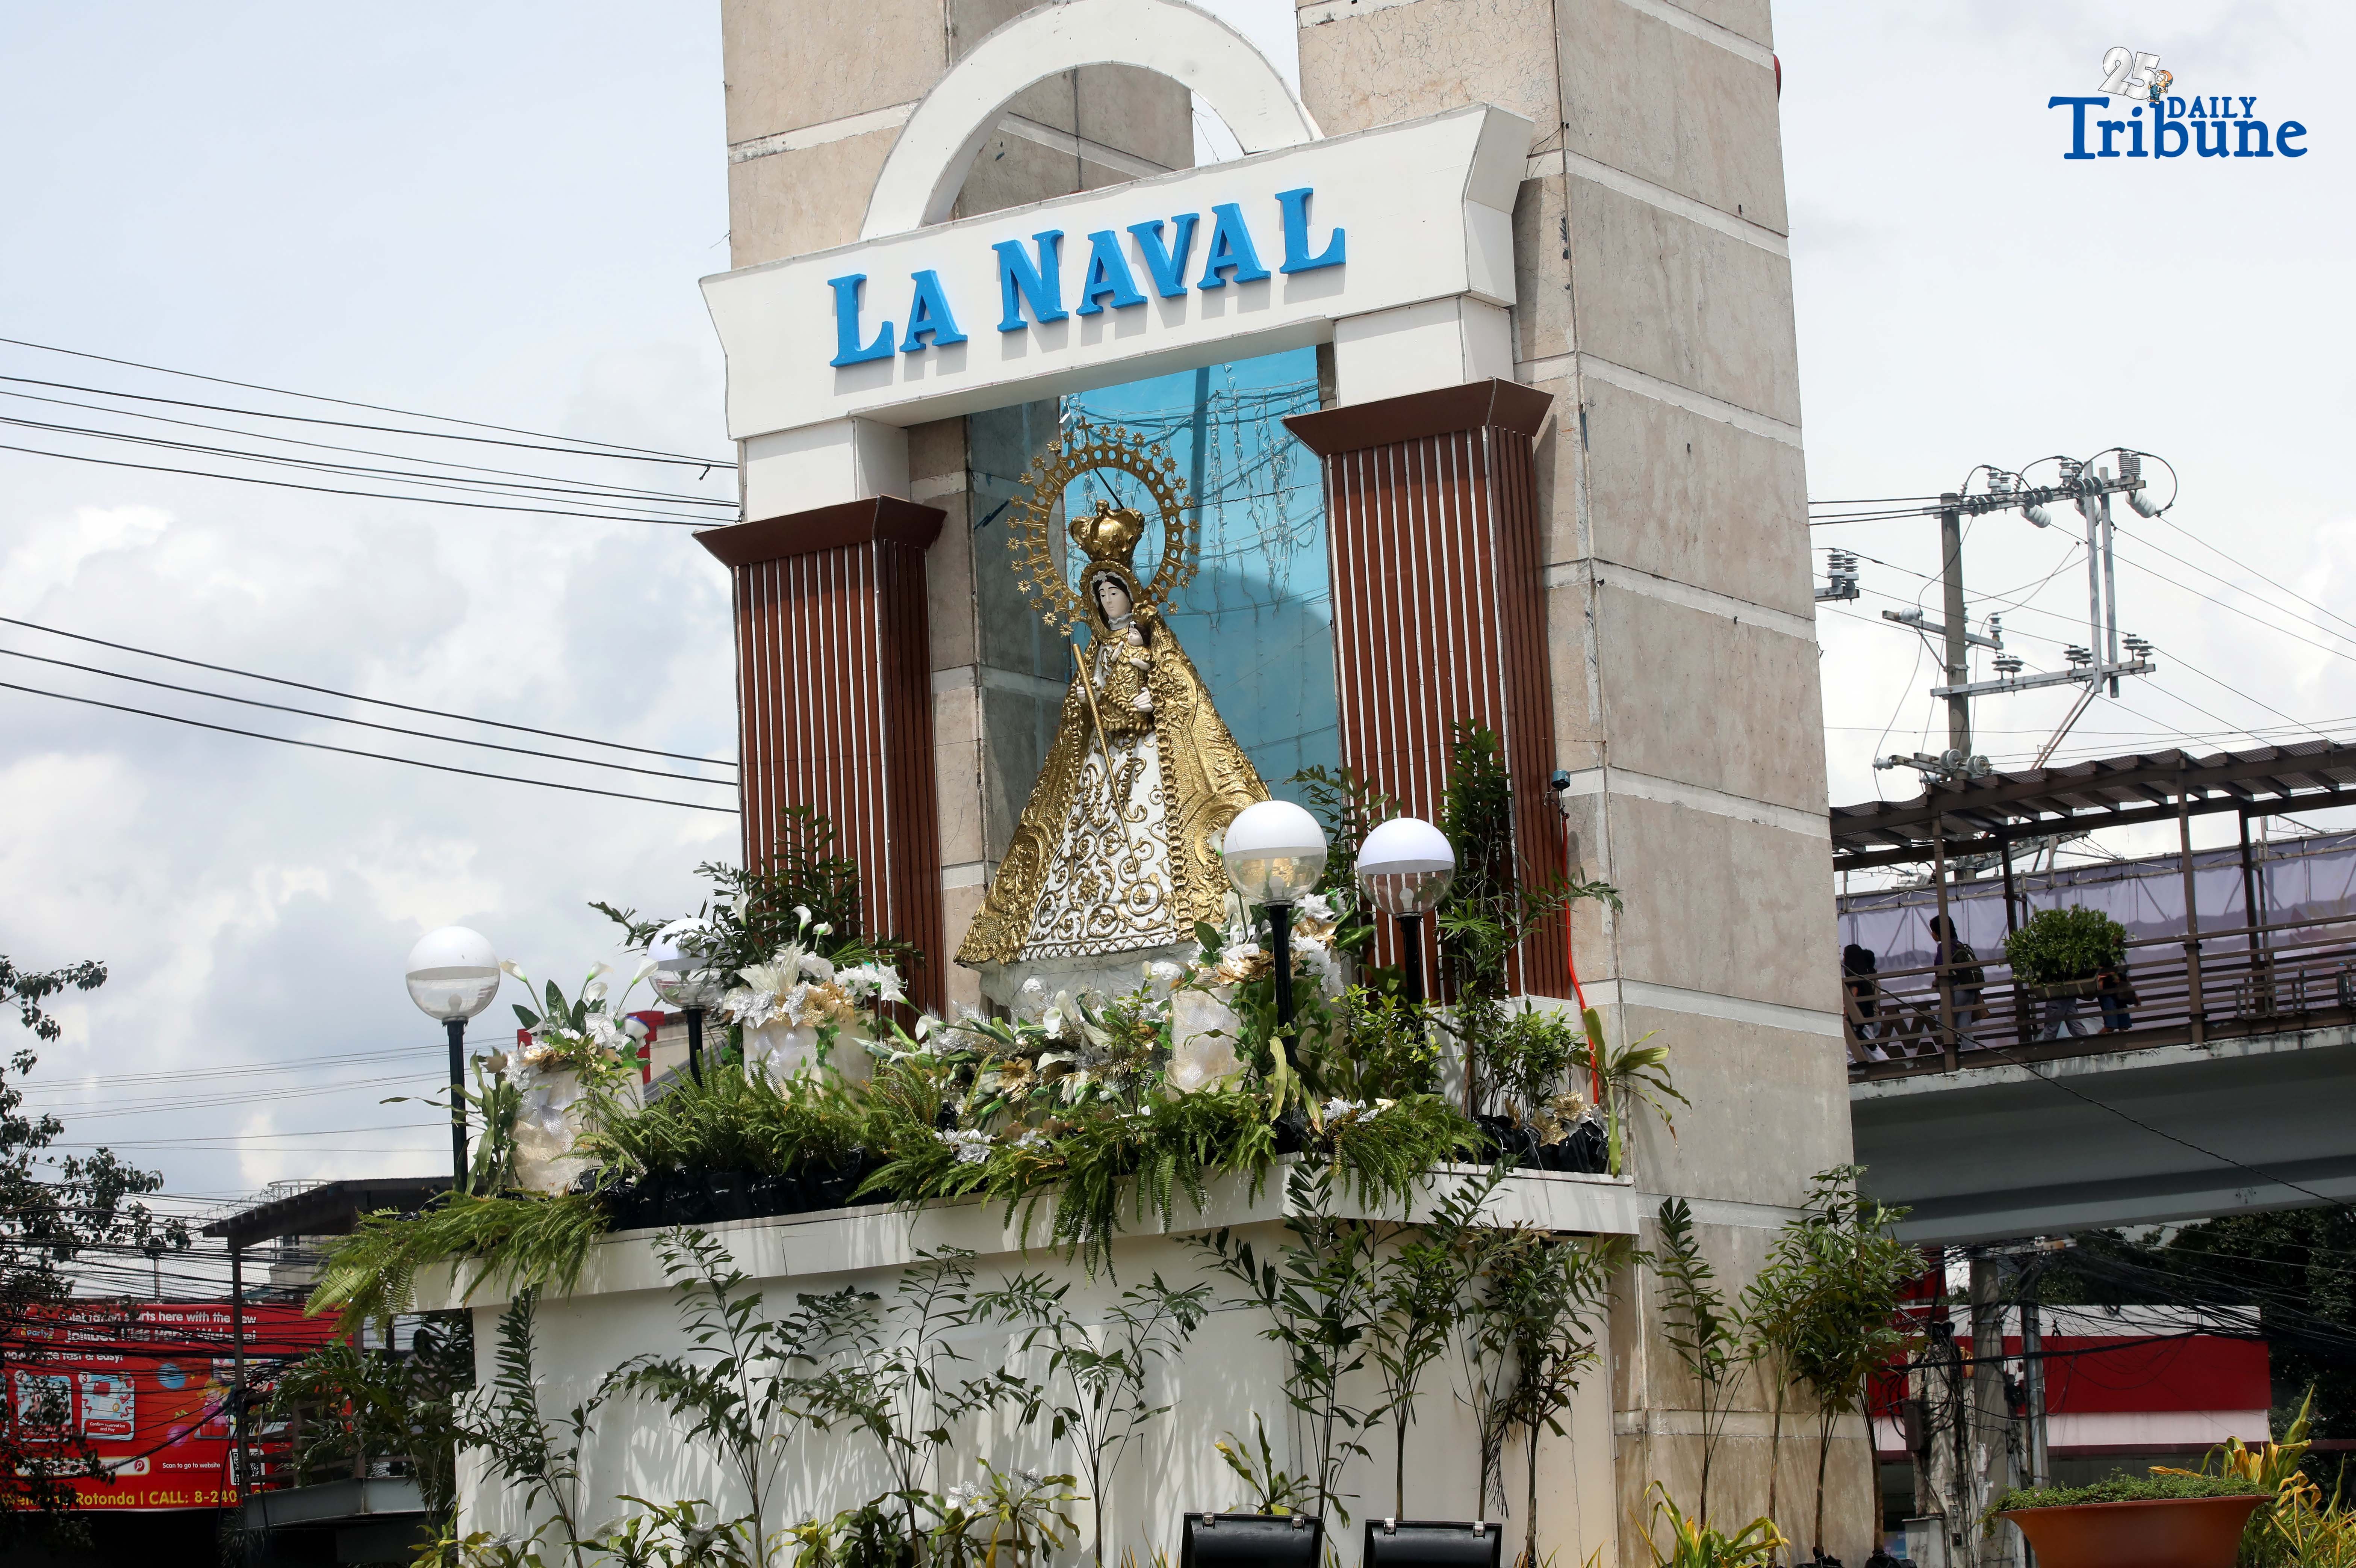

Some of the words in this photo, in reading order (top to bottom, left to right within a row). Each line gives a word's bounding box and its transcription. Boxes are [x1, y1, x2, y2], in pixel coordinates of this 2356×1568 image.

[828, 269, 968, 367] LA
[991, 187, 1346, 333] NAVAL
[159, 1311, 183, 1321] here
[186, 1311, 209, 1322] with
[212, 1311, 230, 1323] the
[76, 1491, 135, 1505] Rotonda
[149, 1491, 189, 1504] CALL:
